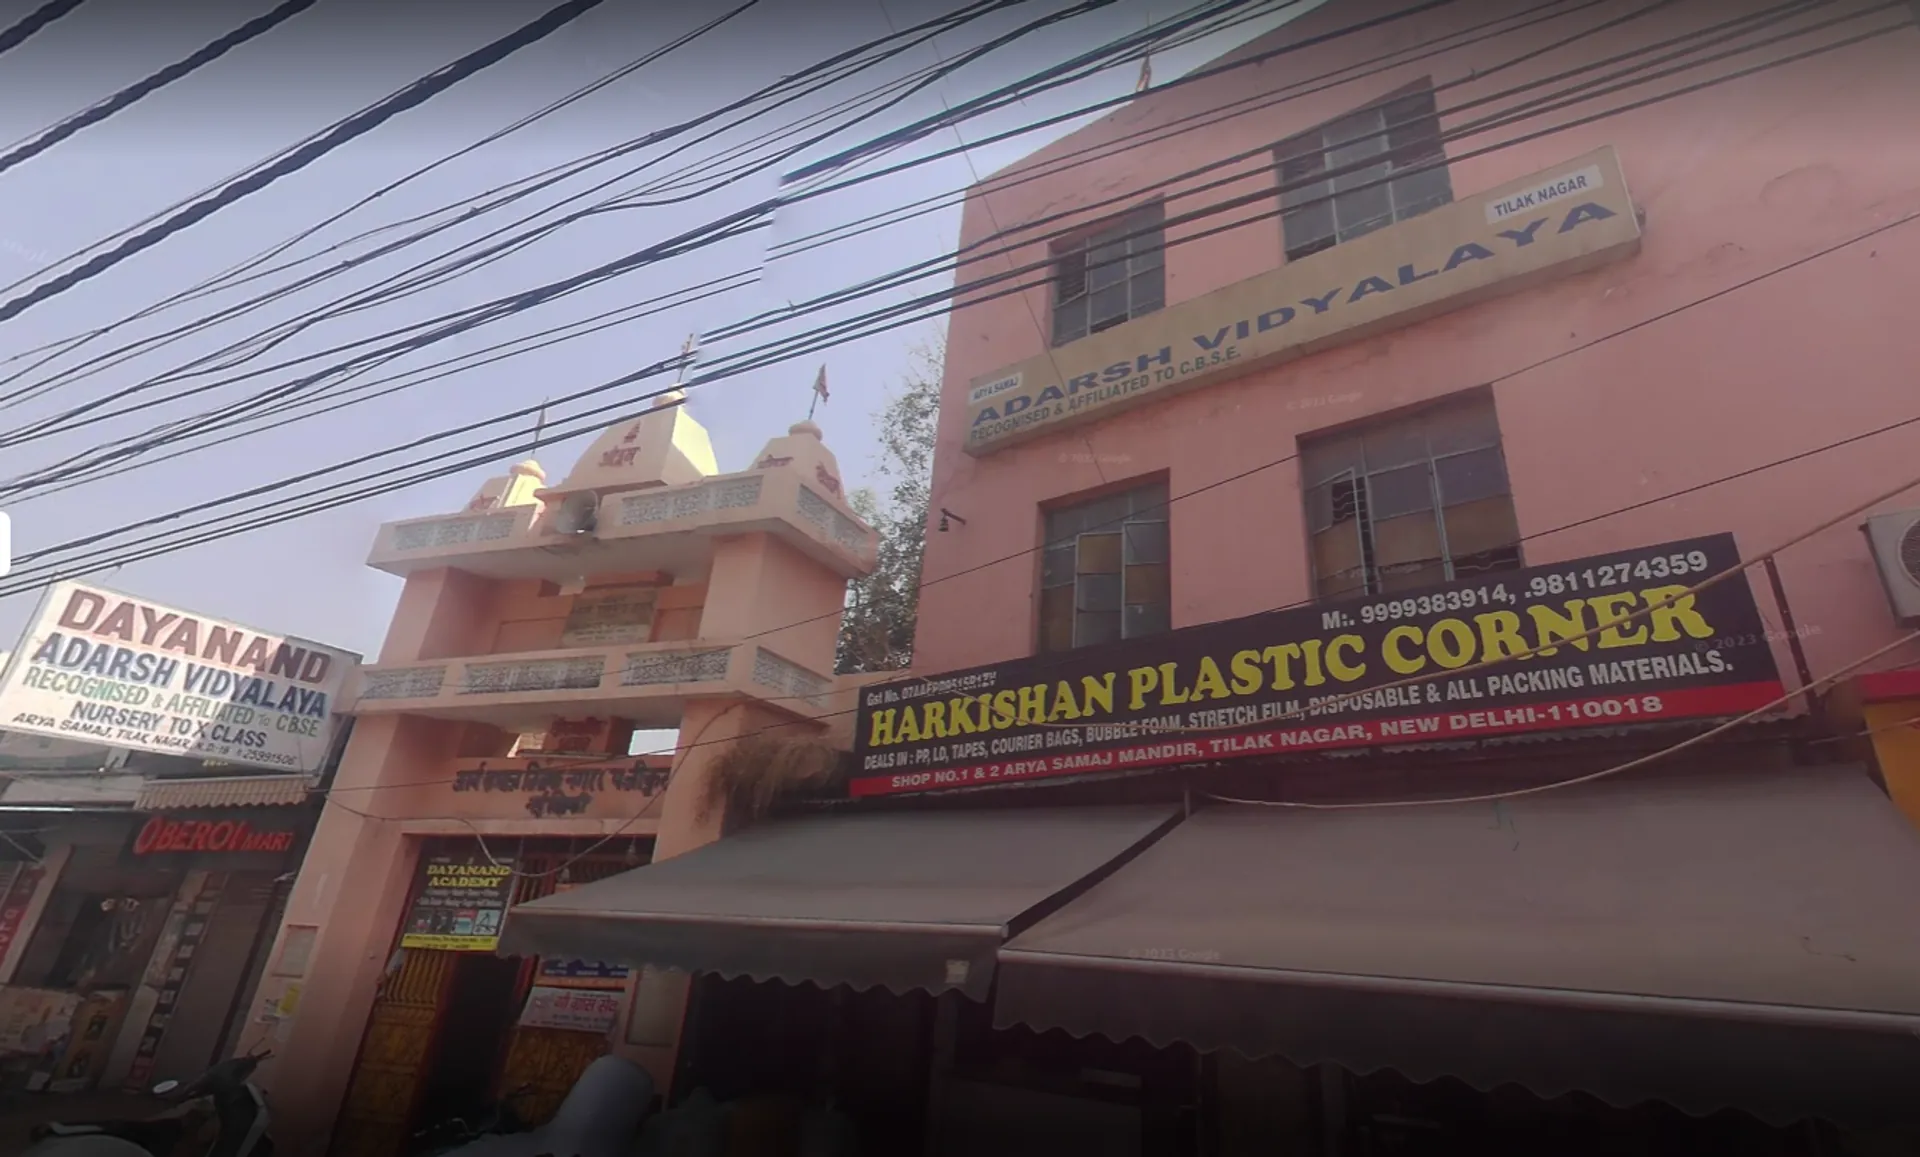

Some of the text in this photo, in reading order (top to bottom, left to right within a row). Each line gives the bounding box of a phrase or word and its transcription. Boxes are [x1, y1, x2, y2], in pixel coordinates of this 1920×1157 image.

[1494, 175, 1588, 216] TILAK NAGAR
[973, 202, 1618, 427] ADARSH VIDYALAYA
[970, 346, 1241, 440] RECOGNISED & AFFILIATED TO C.B.S.E.
[1360, 583, 1516, 624] 9999383914,
[1523, 551, 1708, 598] .9811274359
[58, 588, 332, 684] DAYANAND
[869, 583, 1715, 747] HARKISHAN PLASTIC CORNER
[22, 665, 149, 706] RECOGNISED
[164, 691, 253, 726] AFFILIATED
[276, 714, 321, 738] CBSE
[31, 632, 328, 719] ADARSH VIDYALAYA
[864, 754, 895, 770] DEALS
[897, 752, 908, 766] IN
[952, 740, 989, 760] TAPES,
[991, 734, 1043, 755] COURIER
[1046, 728, 1083, 747] BAGS,
[1086, 720, 1137, 742] BUBBLE
[1142, 714, 1185, 735] FOAM,
[1189, 703, 1257, 728] STRETCH
[1261, 699, 1305, 721] FILM,
[1308, 685, 1421, 717] DISPOSABLE
[1427, 683, 1441, 702] &
[1446, 679, 1483, 700] ALL
[1487, 666, 1584, 696] PACKING
[1588, 649, 1735, 687] MATERIALS.
[12, 712, 56, 728] ARYA
[116, 728, 150, 744] TILAK
[70, 700, 268, 748] NURSERY TO X CLASS
[892, 695, 1664, 788] SHOP NO.1 & 2 ARYA SAMAJ MANDIR, TILAK NAGAR, NEW DELHI-110018
[132, 816, 295, 855] OBEROI MART
[426, 864, 512, 876] DAYANAND
[428, 876, 504, 888] ACADEMY
